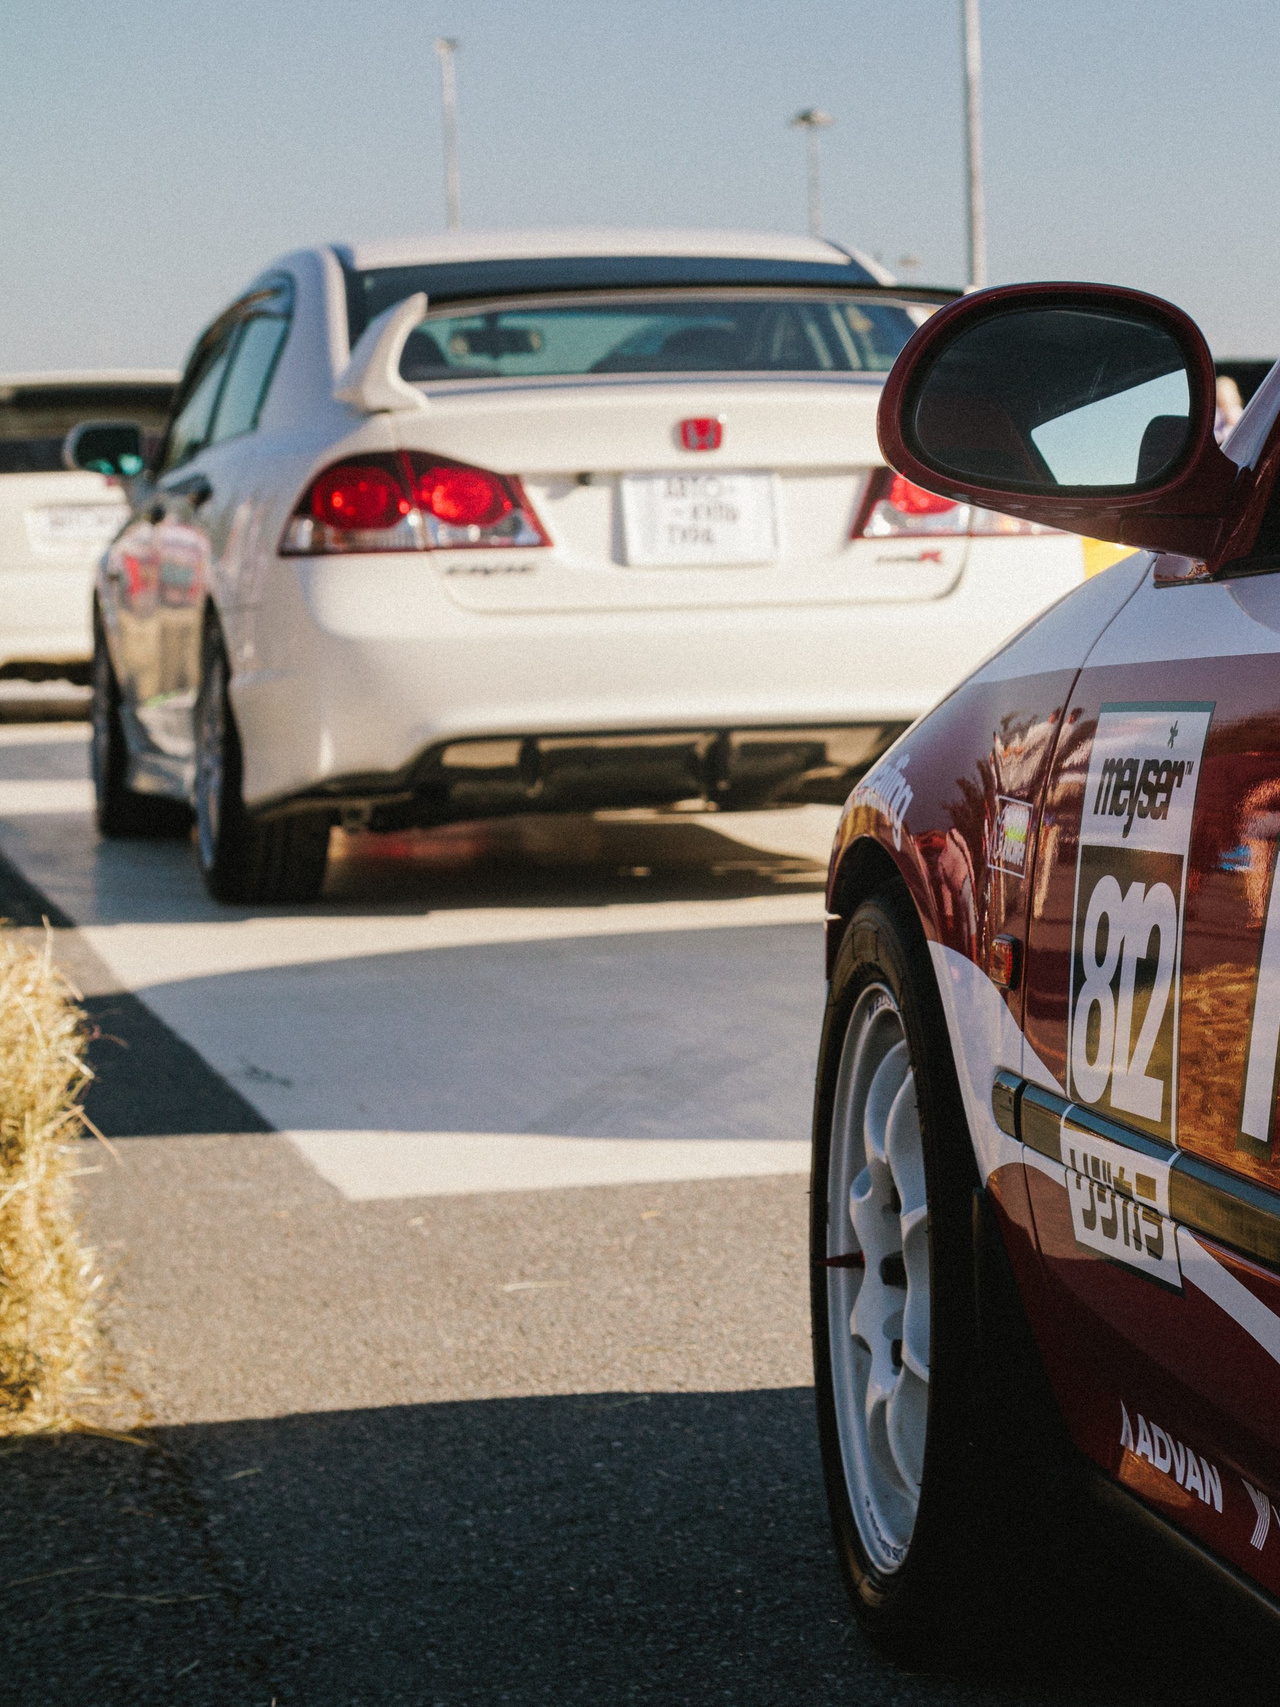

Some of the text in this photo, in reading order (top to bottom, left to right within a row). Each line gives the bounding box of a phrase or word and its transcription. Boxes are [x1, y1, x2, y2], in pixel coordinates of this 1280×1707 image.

[1093, 757, 1185, 839] meyser
[1072, 874, 1178, 1123] 812
[1135, 1412, 1224, 1514] ADVAN
